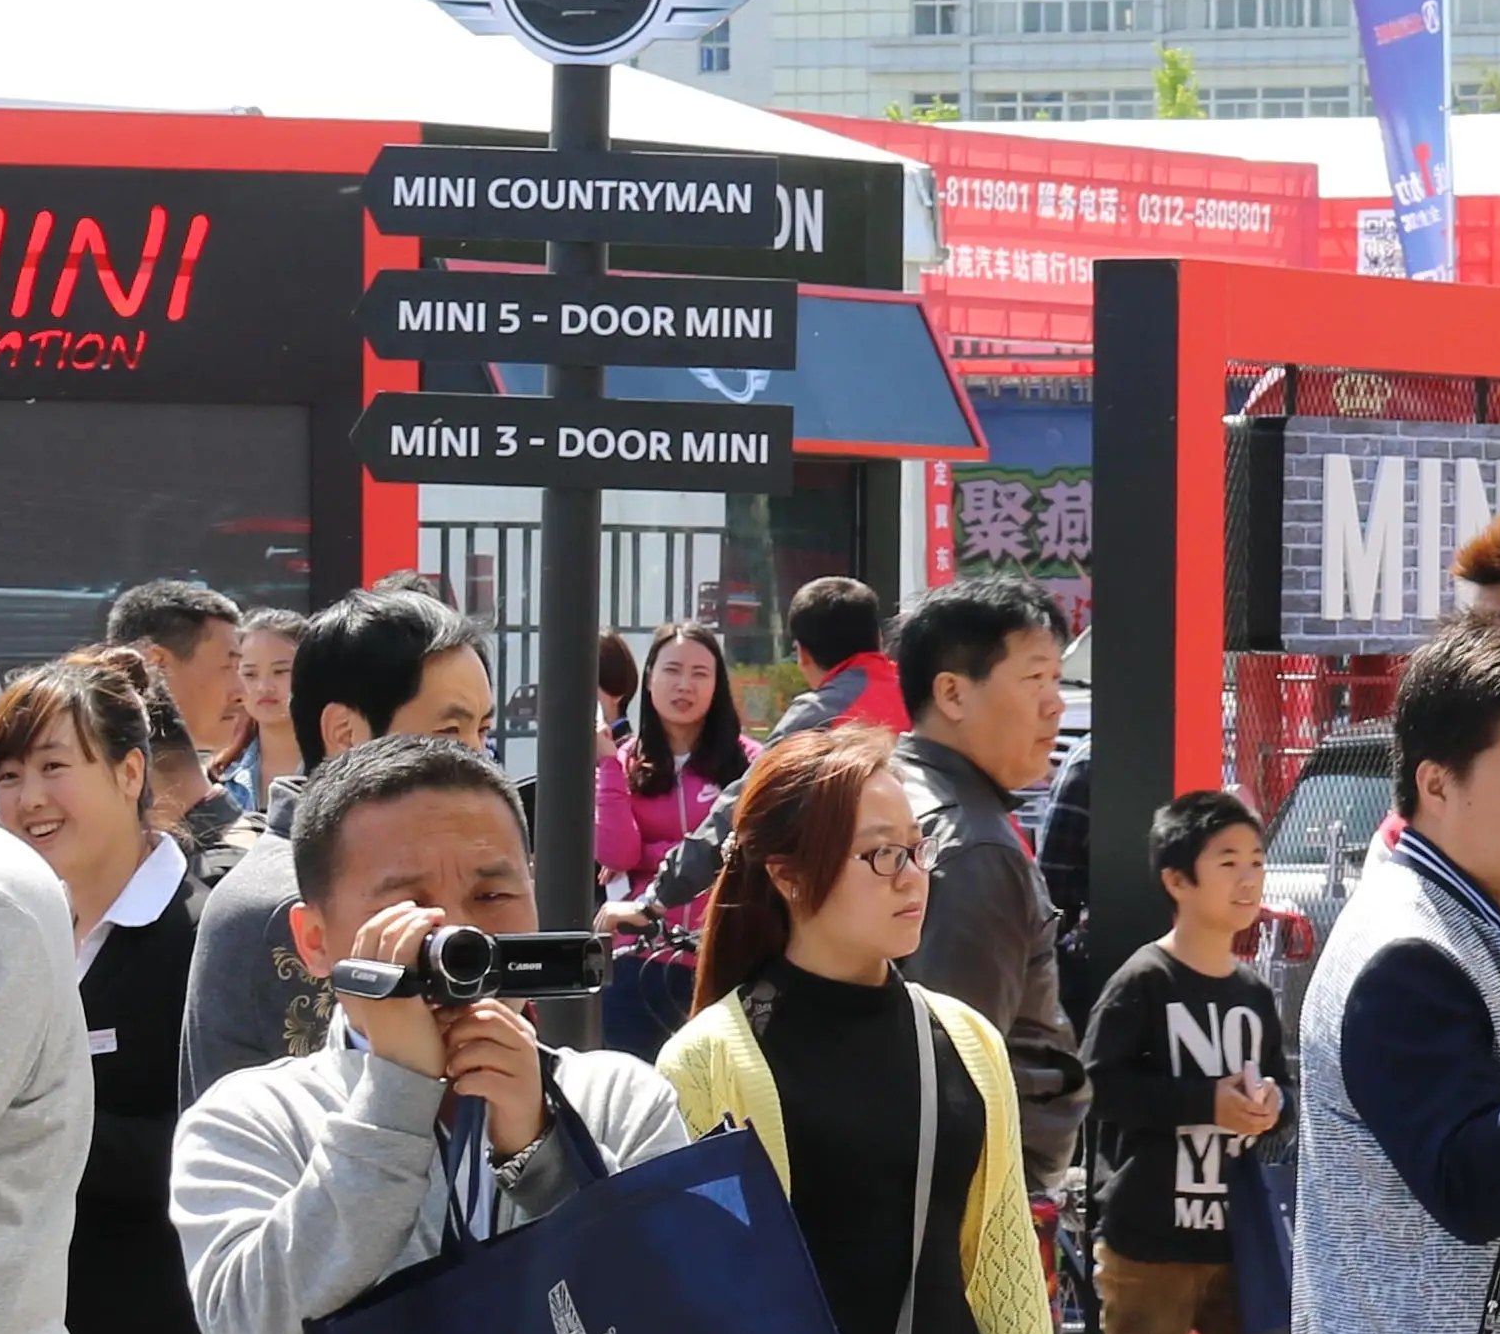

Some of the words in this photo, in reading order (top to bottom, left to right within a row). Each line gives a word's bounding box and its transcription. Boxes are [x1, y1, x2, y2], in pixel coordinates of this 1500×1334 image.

[393, 177, 476, 208] MINI
[487, 178, 753, 214] COUNTRYMAN
[398, 300, 486, 333] MINI
[498, 302, 520, 334] 5
[560, 304, 676, 336] DOOR
[685, 308, 772, 339] MINI
[390, 424, 479, 458] MINI
[496, 427, 517, 458] 3
[558, 428, 672, 462] DOOR
[682, 431, 769, 463] MINI
[508, 962, 542, 971] Canon
[1166, 1001, 1263, 1078] NO
